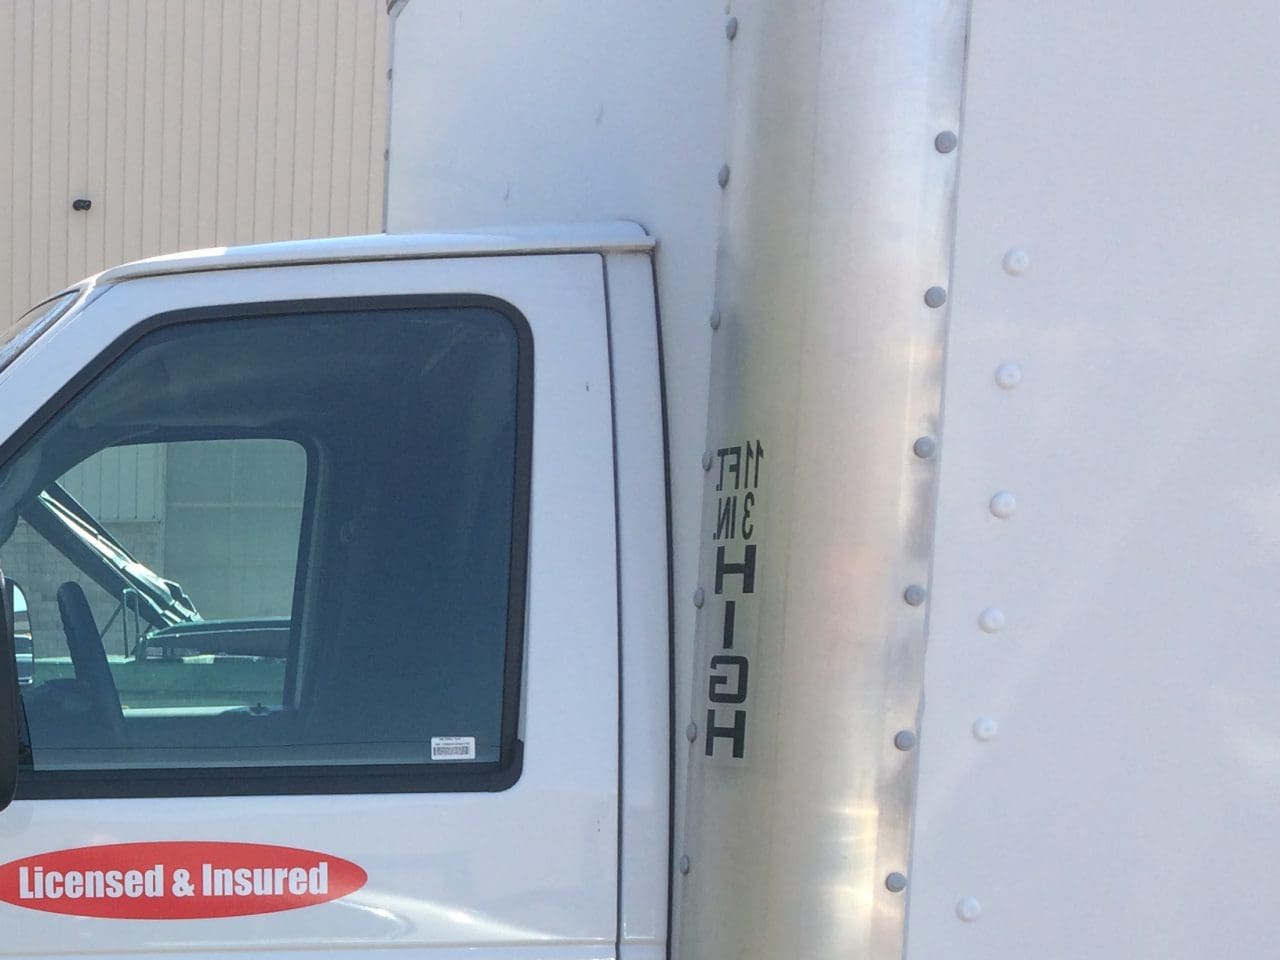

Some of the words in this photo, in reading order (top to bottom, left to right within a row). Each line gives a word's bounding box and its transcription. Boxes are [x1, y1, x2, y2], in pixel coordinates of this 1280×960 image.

[18, 863, 164, 899] Licensed
[171, 868, 195, 897] &
[202, 861, 329, 897] Insured
